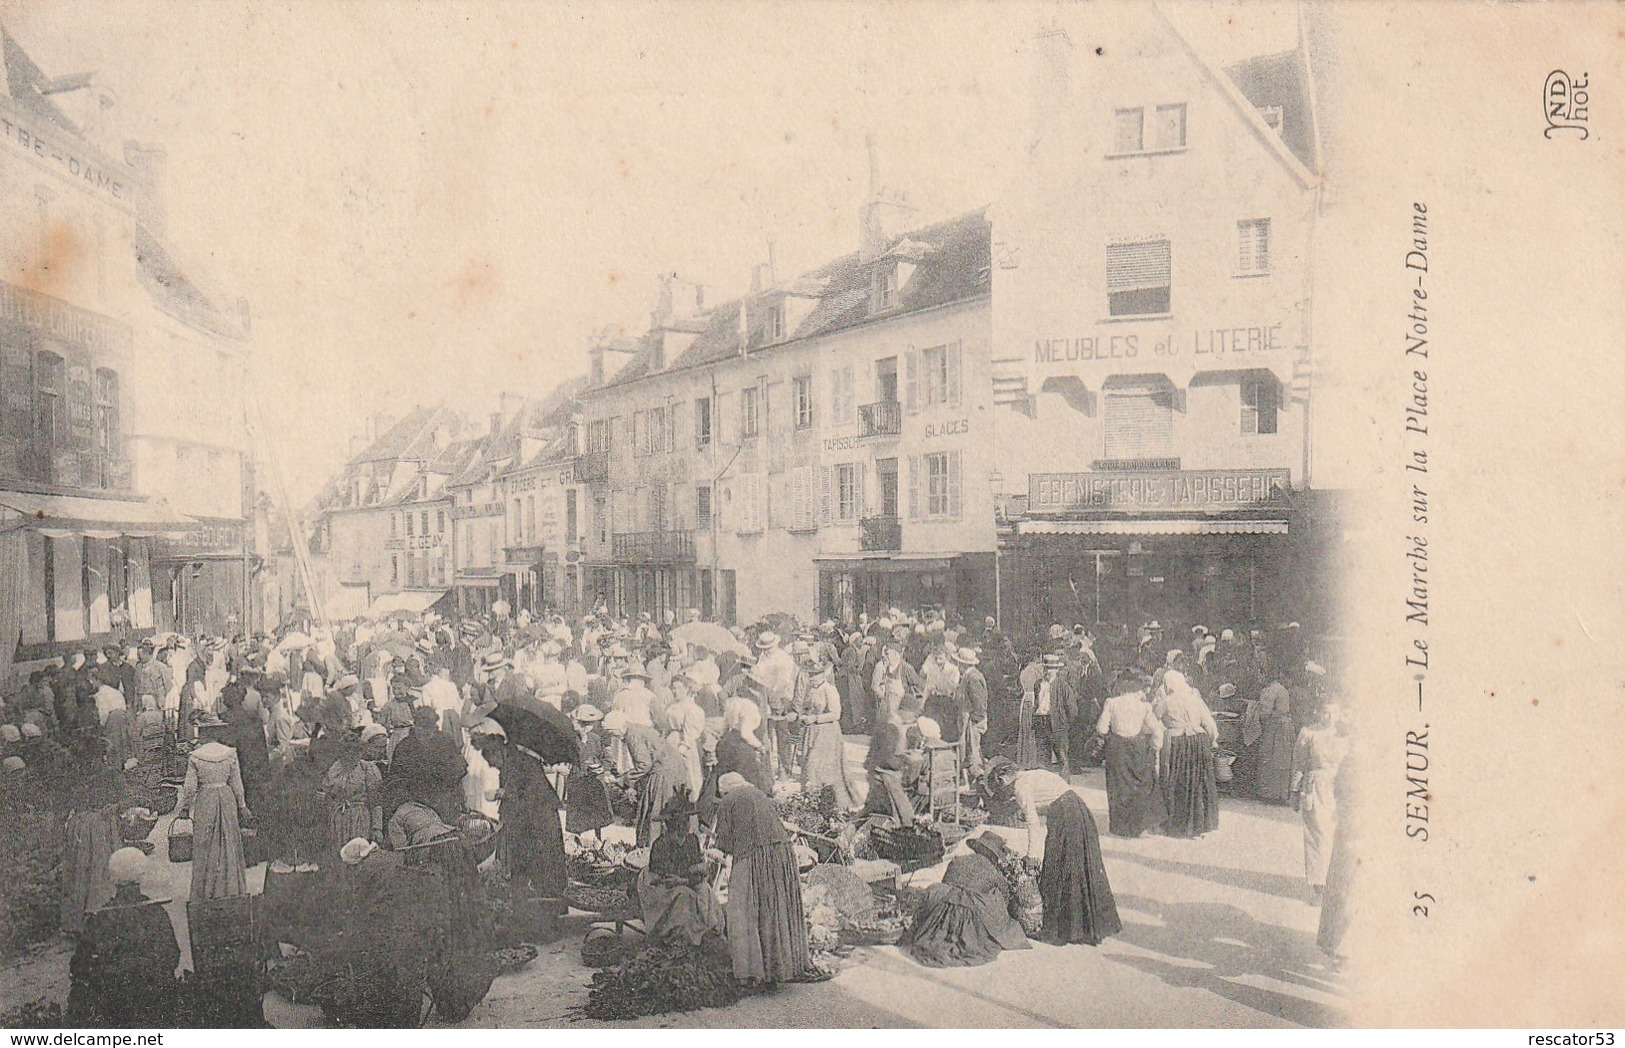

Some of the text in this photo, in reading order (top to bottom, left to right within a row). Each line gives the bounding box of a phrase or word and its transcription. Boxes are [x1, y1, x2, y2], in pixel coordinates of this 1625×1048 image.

[1034, 335, 1139, 364] MEUBLES
[1154, 335, 1179, 357] et
[924, 419, 969, 438] GLACES
[1039, 475, 1285, 505] EBENISTERIE TAPISSERIE
[1406, 203, 1435, 917] 25 SEMUR. Le Marché sur la Place Notre-Dame
